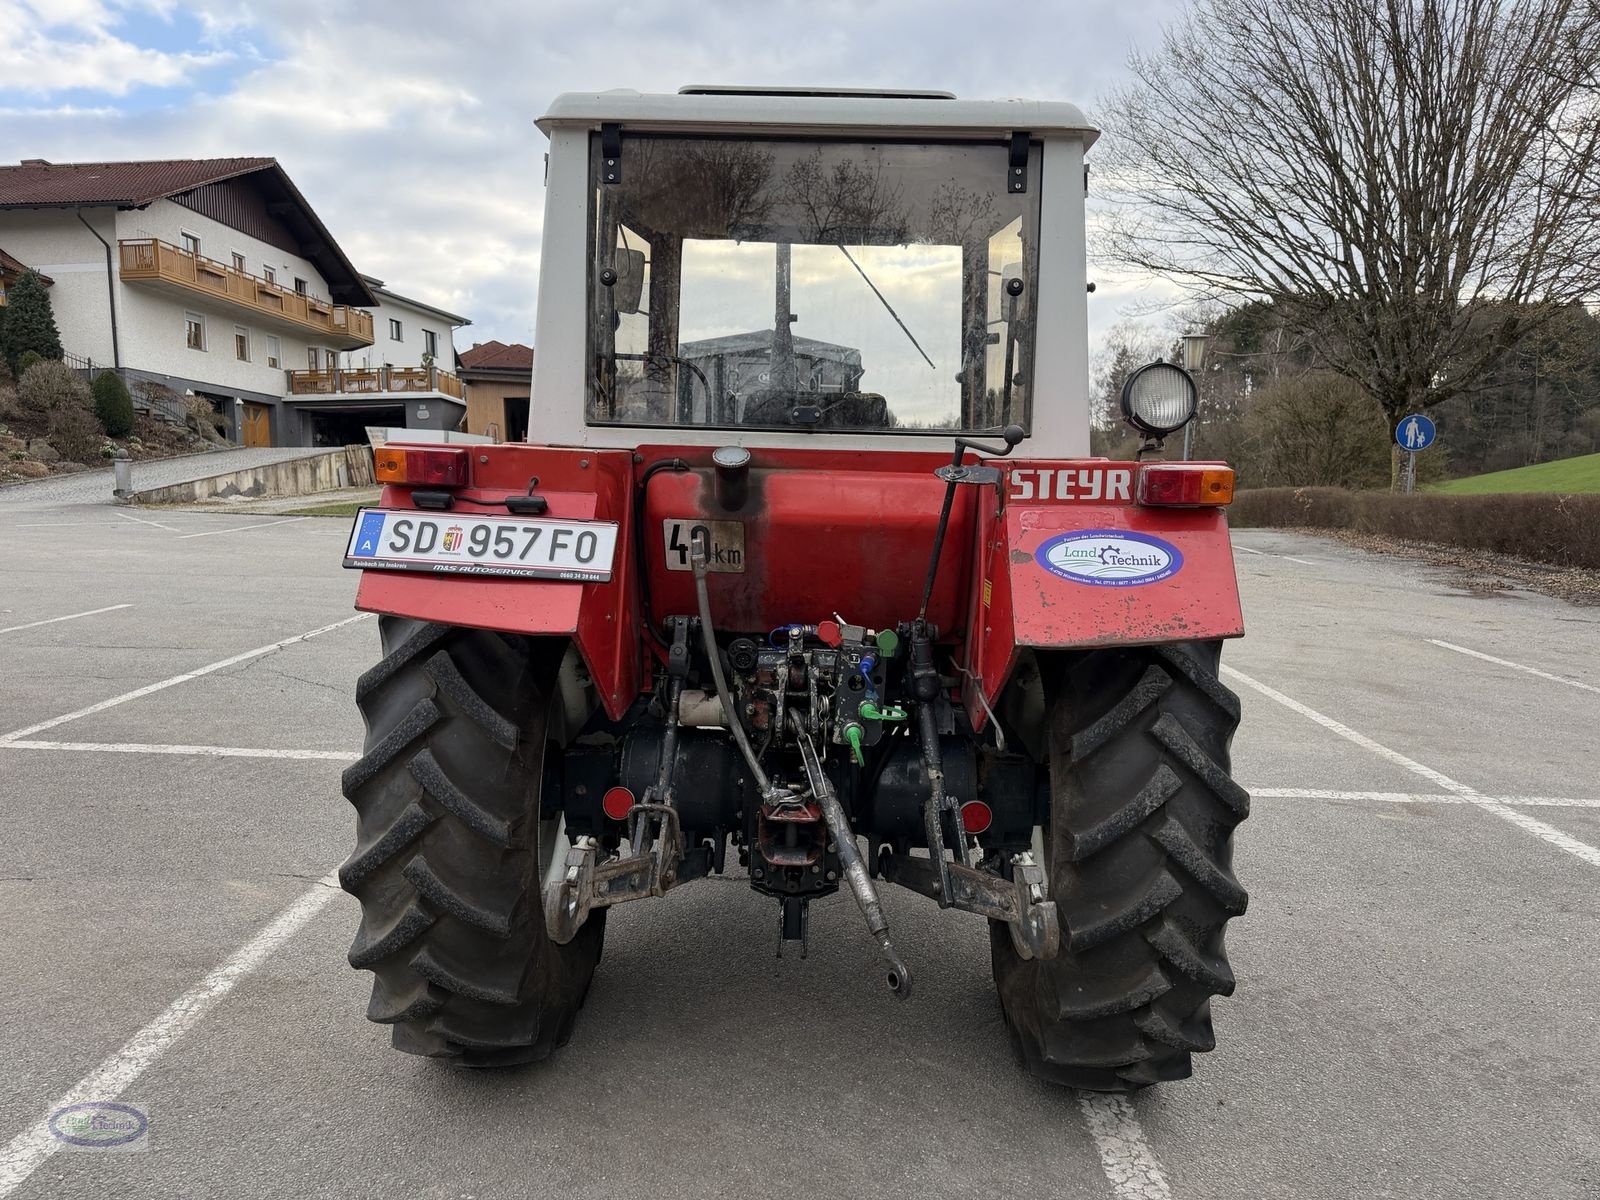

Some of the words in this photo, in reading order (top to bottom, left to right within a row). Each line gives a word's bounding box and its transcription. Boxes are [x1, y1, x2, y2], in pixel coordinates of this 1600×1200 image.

[1010, 469, 1131, 500] STEYR
[361, 540, 371, 550] A
[389, 520, 439, 553] SD
[468, 524, 542, 560] 957
[714, 543, 741, 564] km
[1064, 547, 1097, 558] Land
[1109, 555, 1161, 566] Technik
[433, 564, 457, 572] M&S
[459, 566, 535, 576] AUTOSERVICE
